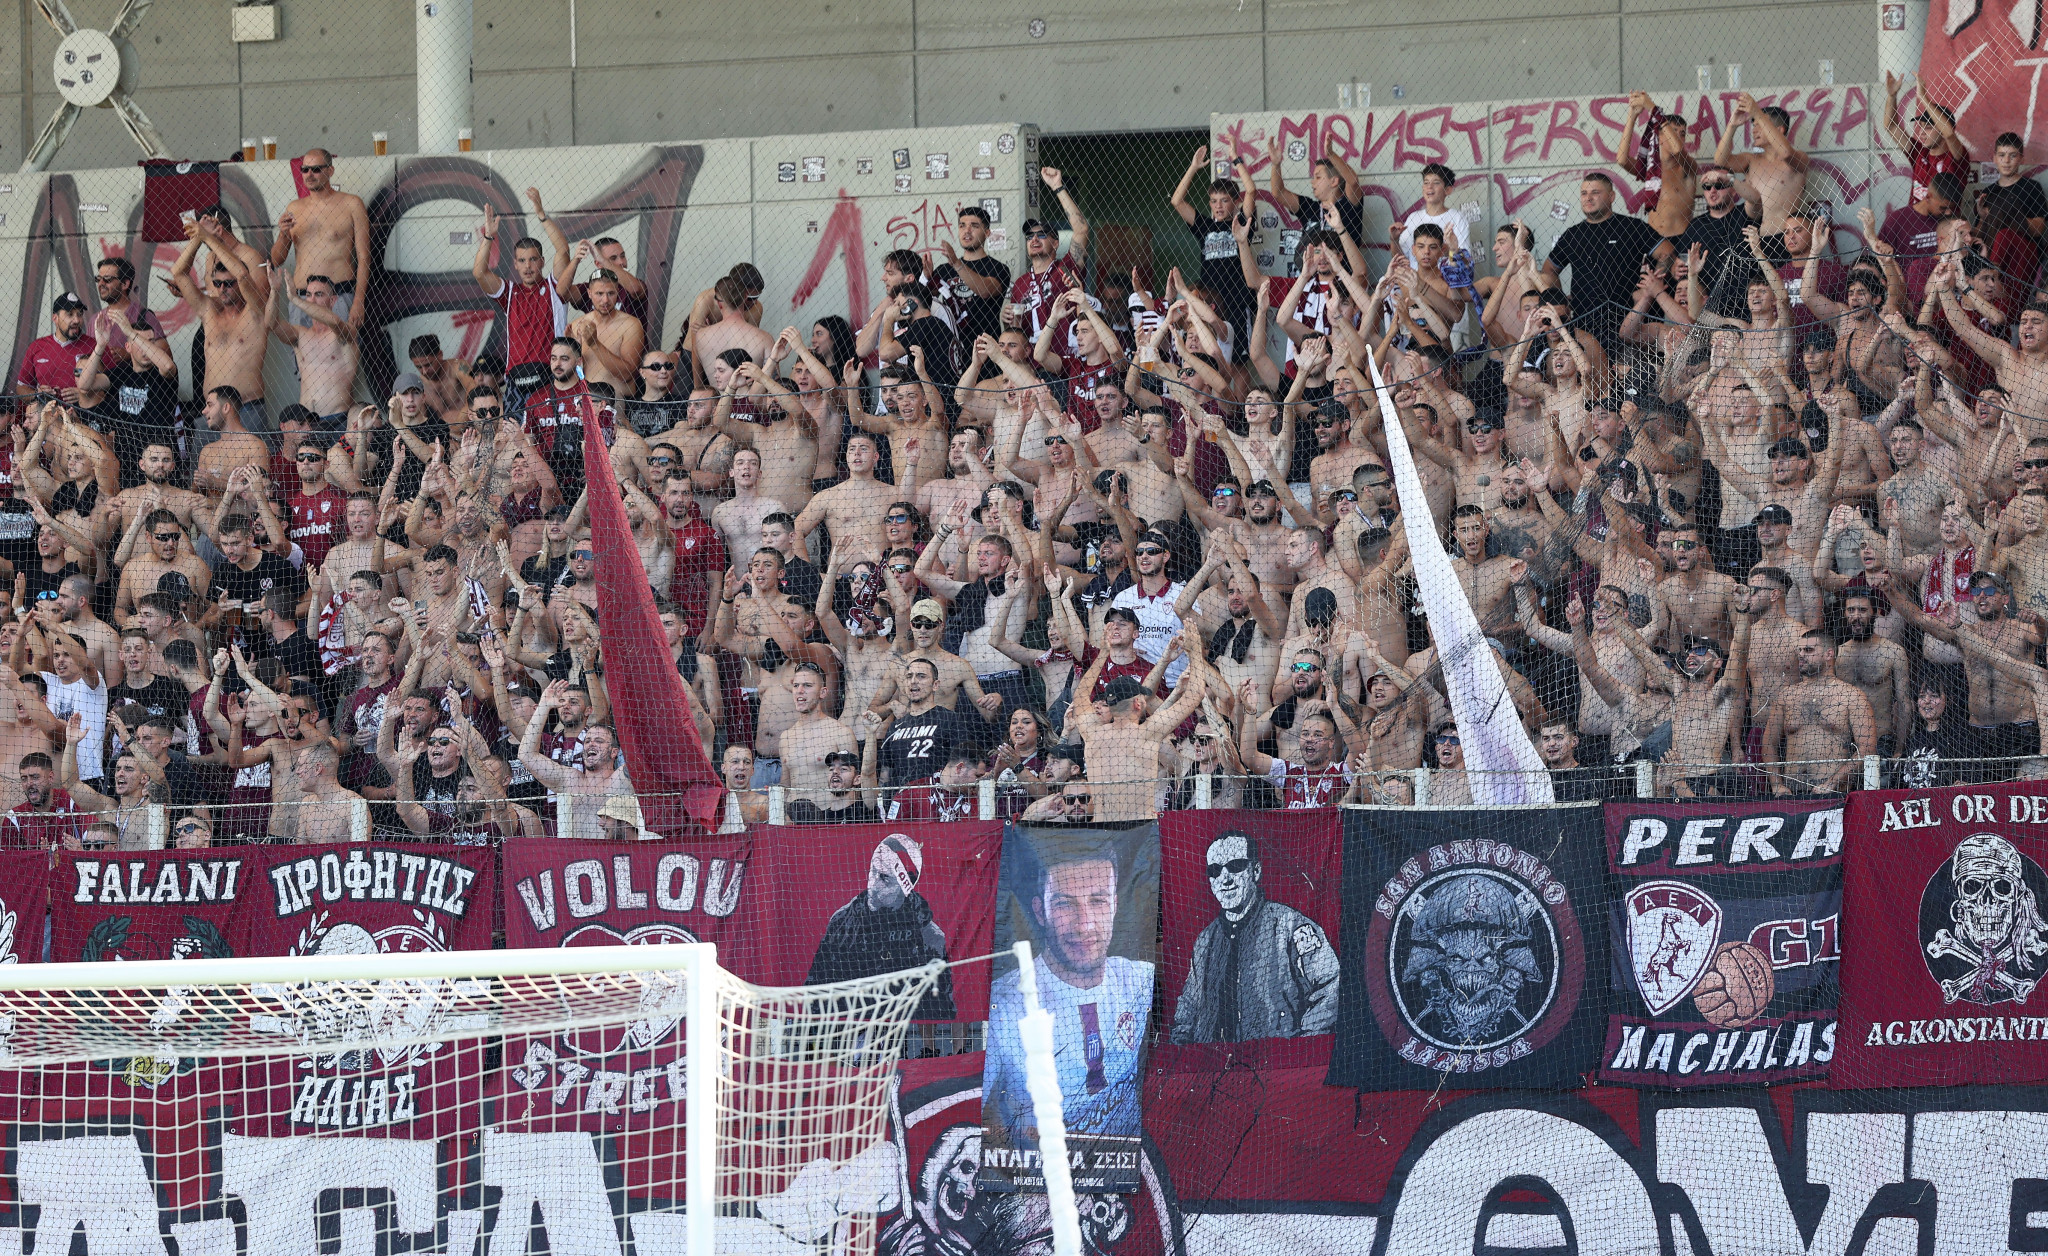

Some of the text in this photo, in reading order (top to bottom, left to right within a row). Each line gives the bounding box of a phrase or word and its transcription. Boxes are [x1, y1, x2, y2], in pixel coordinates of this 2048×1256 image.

[290, 521, 332, 539] novibet
[889, 725, 938, 743] MIAMI
[907, 738, 934, 758] 22
[1621, 807, 1844, 866] PERA
[1879, 798, 1942, 833] AEL
[1952, 794, 1998, 824] OR
[74, 861, 242, 903] FALANI
[271, 850, 476, 916] ΠΡΟΦΗΤΗΣ
[515, 853, 744, 931] VOLOU
[1375, 838, 1567, 920] SAN ANTONIO
[1398, 1036, 1534, 1073] LARISSA
[1610, 1021, 1838, 1074] MACHALAS
[290, 1073, 417, 1127] ΗΛΙΑΣ
